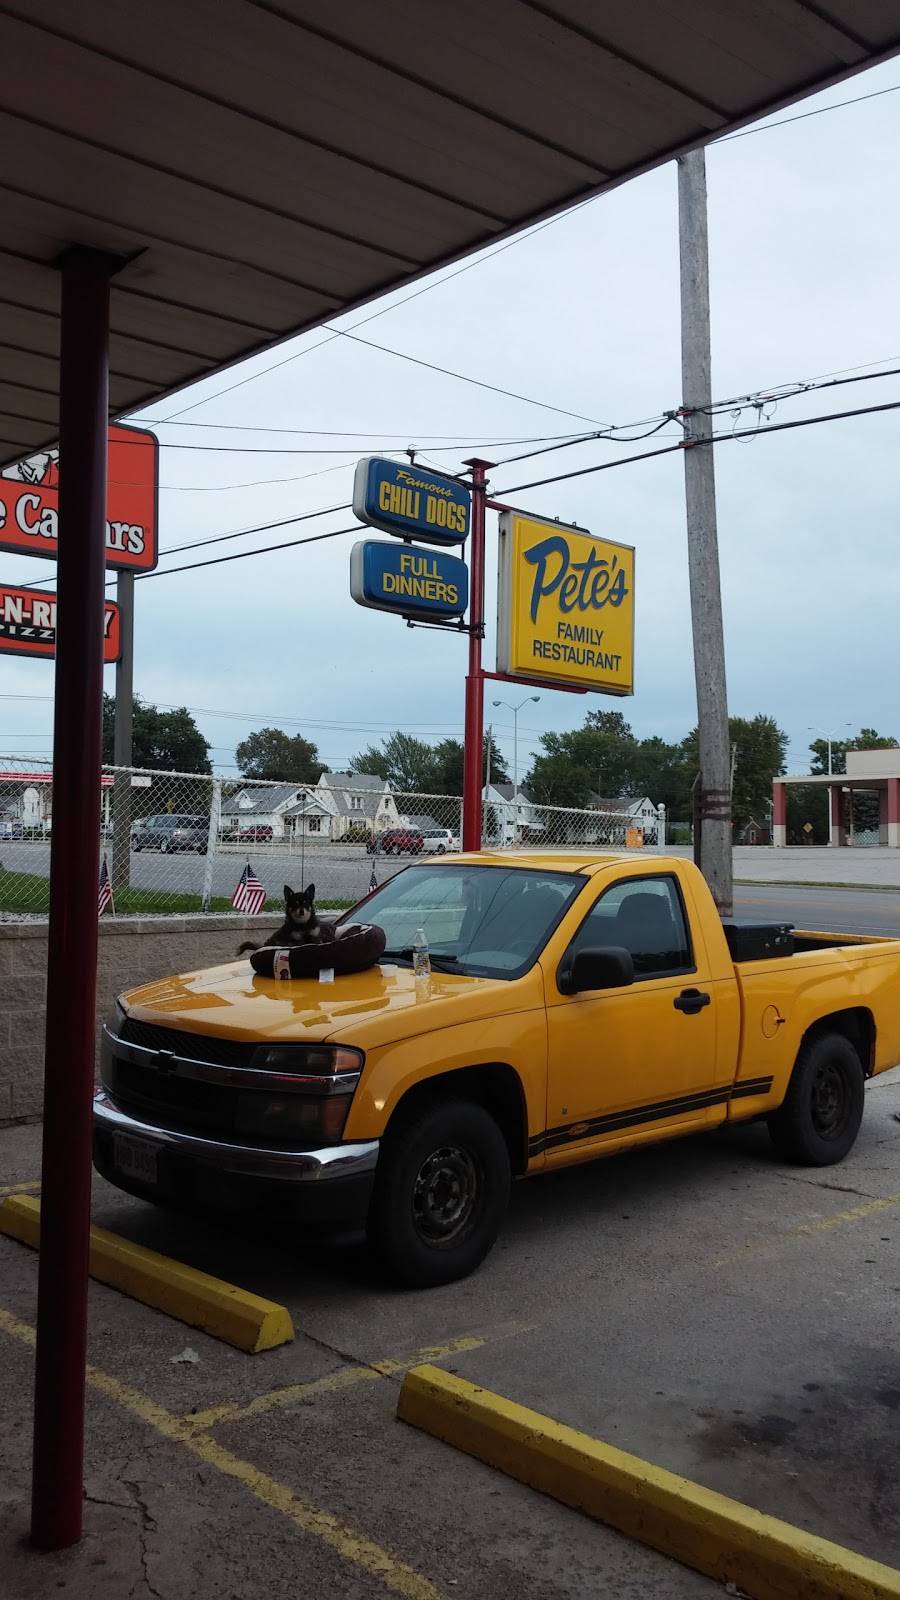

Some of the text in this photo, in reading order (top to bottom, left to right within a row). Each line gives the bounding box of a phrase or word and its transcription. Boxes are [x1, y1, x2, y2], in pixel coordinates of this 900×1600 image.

[395, 470, 454, 497] Famous
[379, 481, 467, 533] CHILI DOGS
[16, 493, 144, 554] Cars
[400, 554, 443, 580] FULL
[523, 535, 629, 625] Pete's
[382, 572, 458, 604] DINNERS
[557, 621, 604, 646] FAMILY
[533, 639, 621, 672] RESTAURANT
